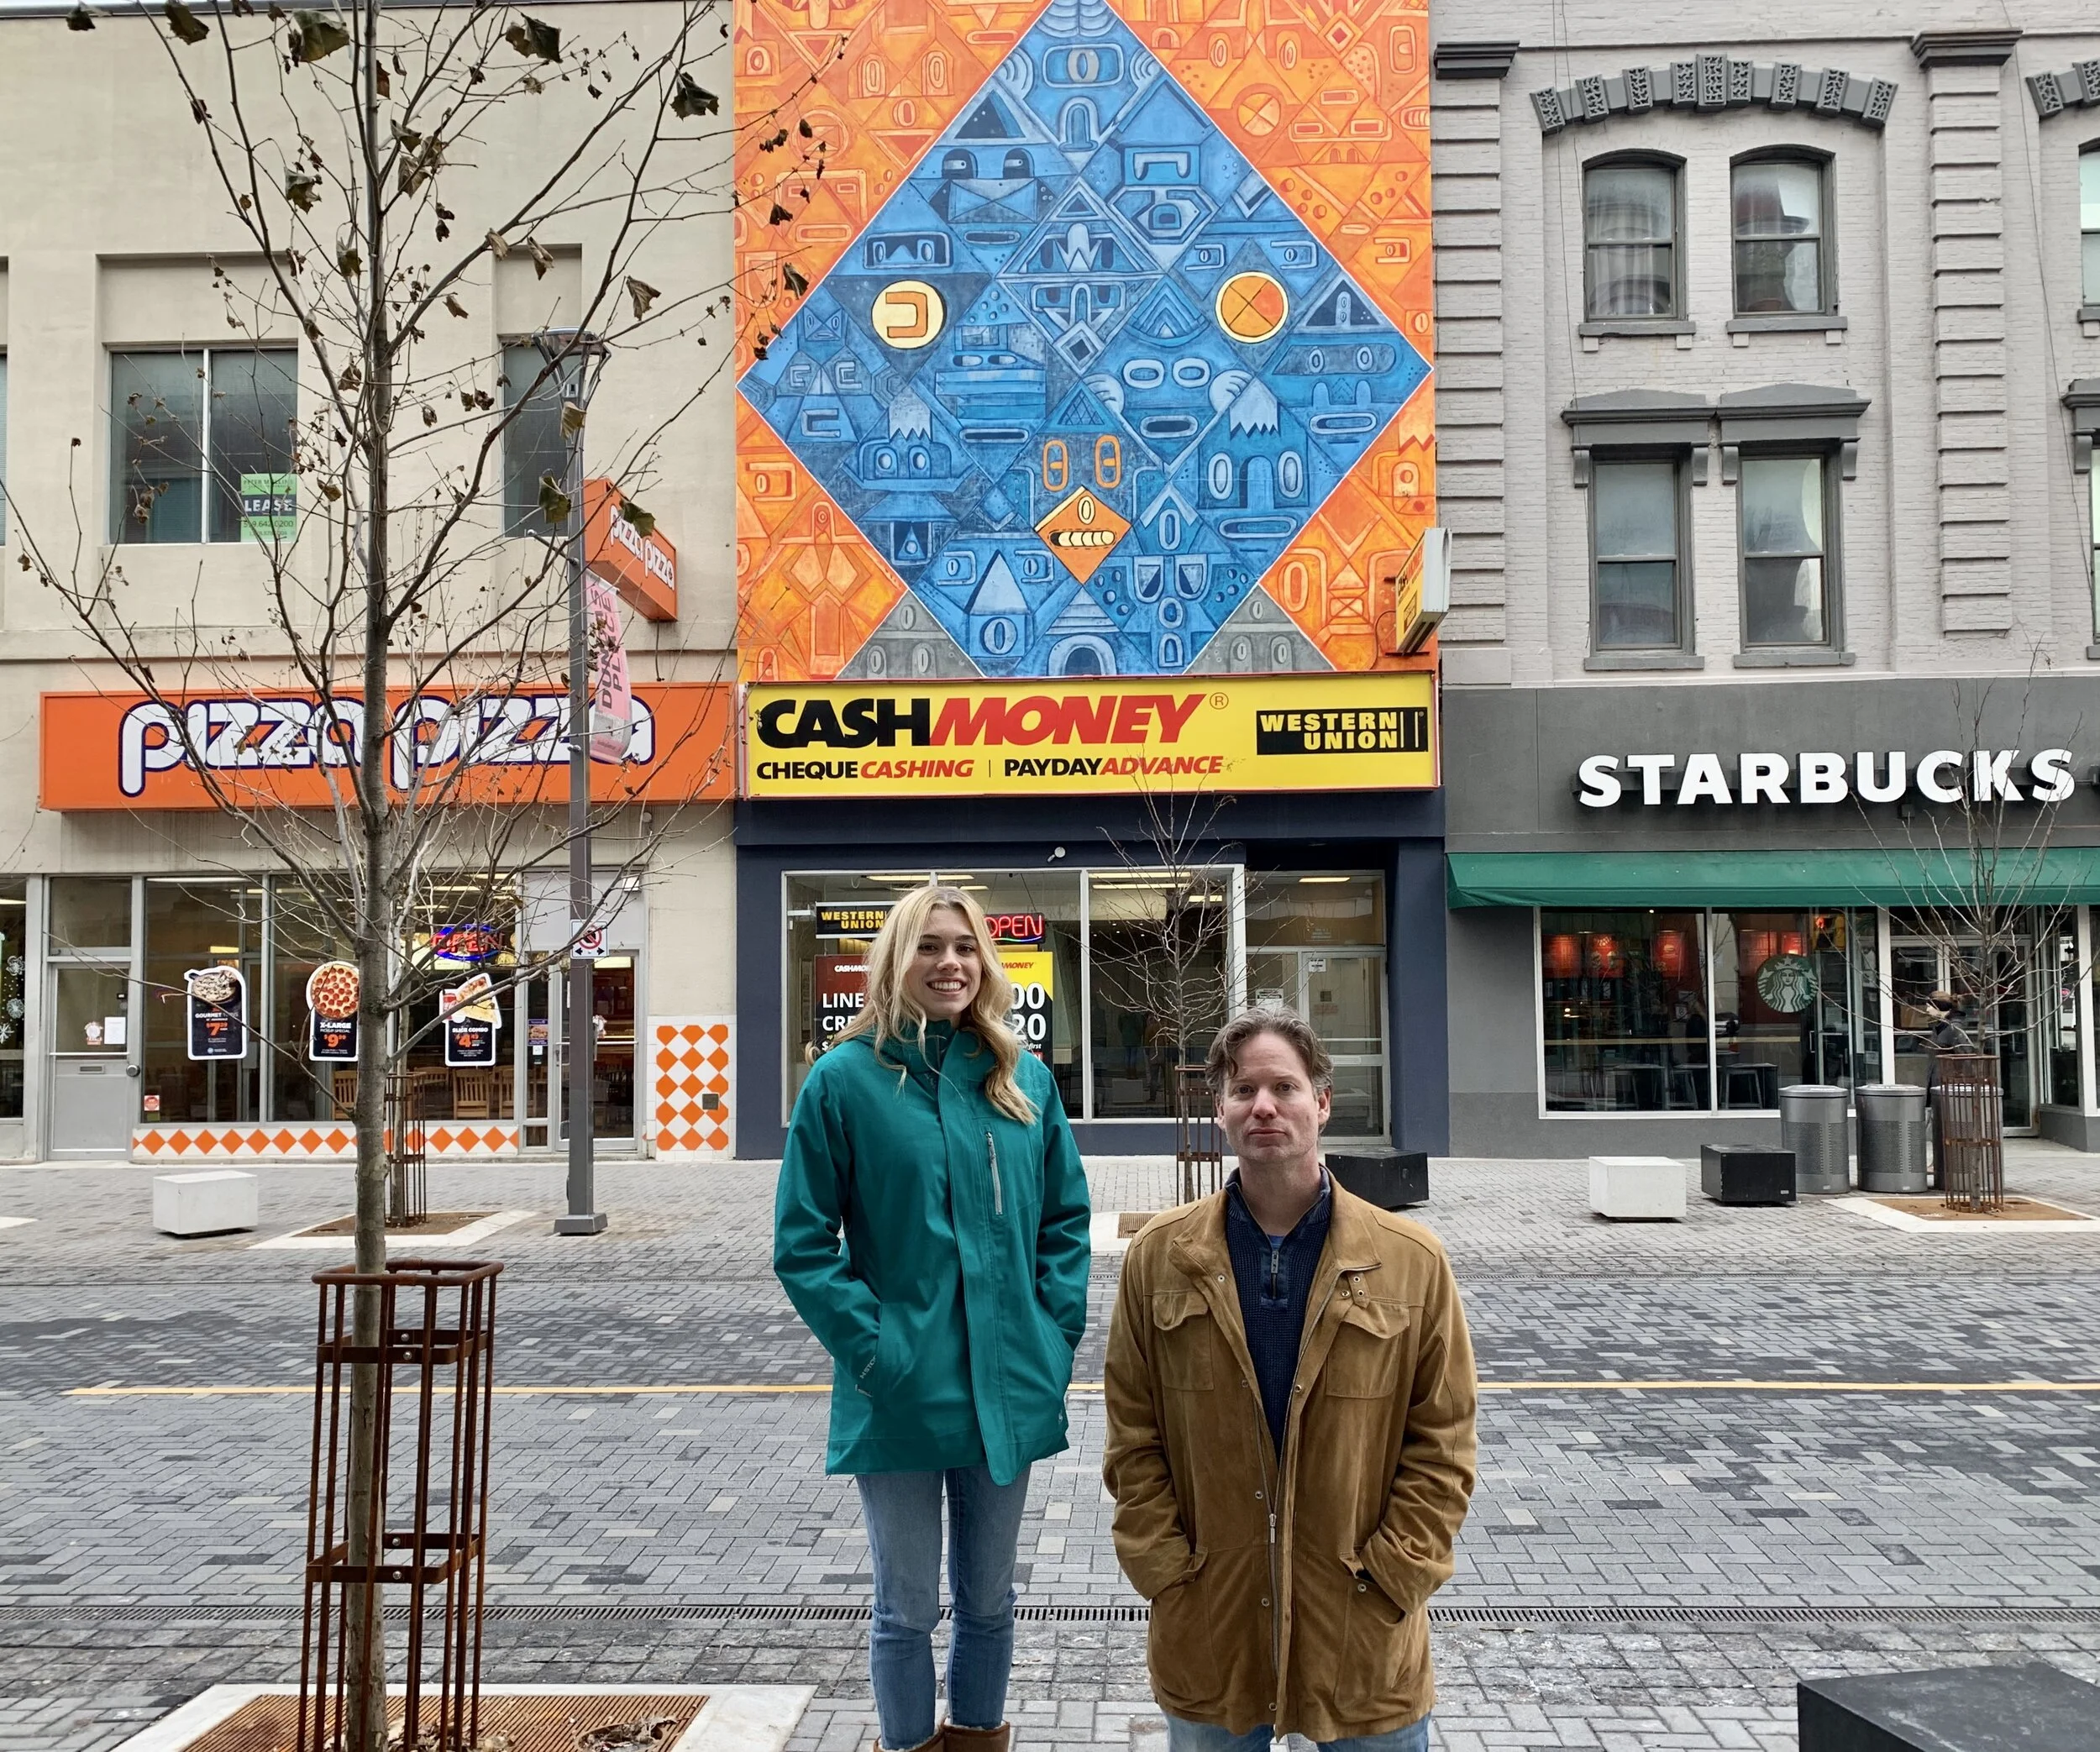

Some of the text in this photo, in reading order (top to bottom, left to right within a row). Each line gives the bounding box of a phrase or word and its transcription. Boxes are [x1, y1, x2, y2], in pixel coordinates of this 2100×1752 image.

[244, 499, 292, 511] LEASE
[644, 538, 675, 590] pizza
[1260, 711, 1397, 732] WESTERN
[1304, 731, 1398, 750] UNION
[1579, 748, 2076, 807] STARBUCKS
[821, 910, 883, 921] WESTERN
[841, 920, 885, 930] UNION
[984, 915, 1042, 937] OPEN
[822, 993, 864, 1008] LINE
